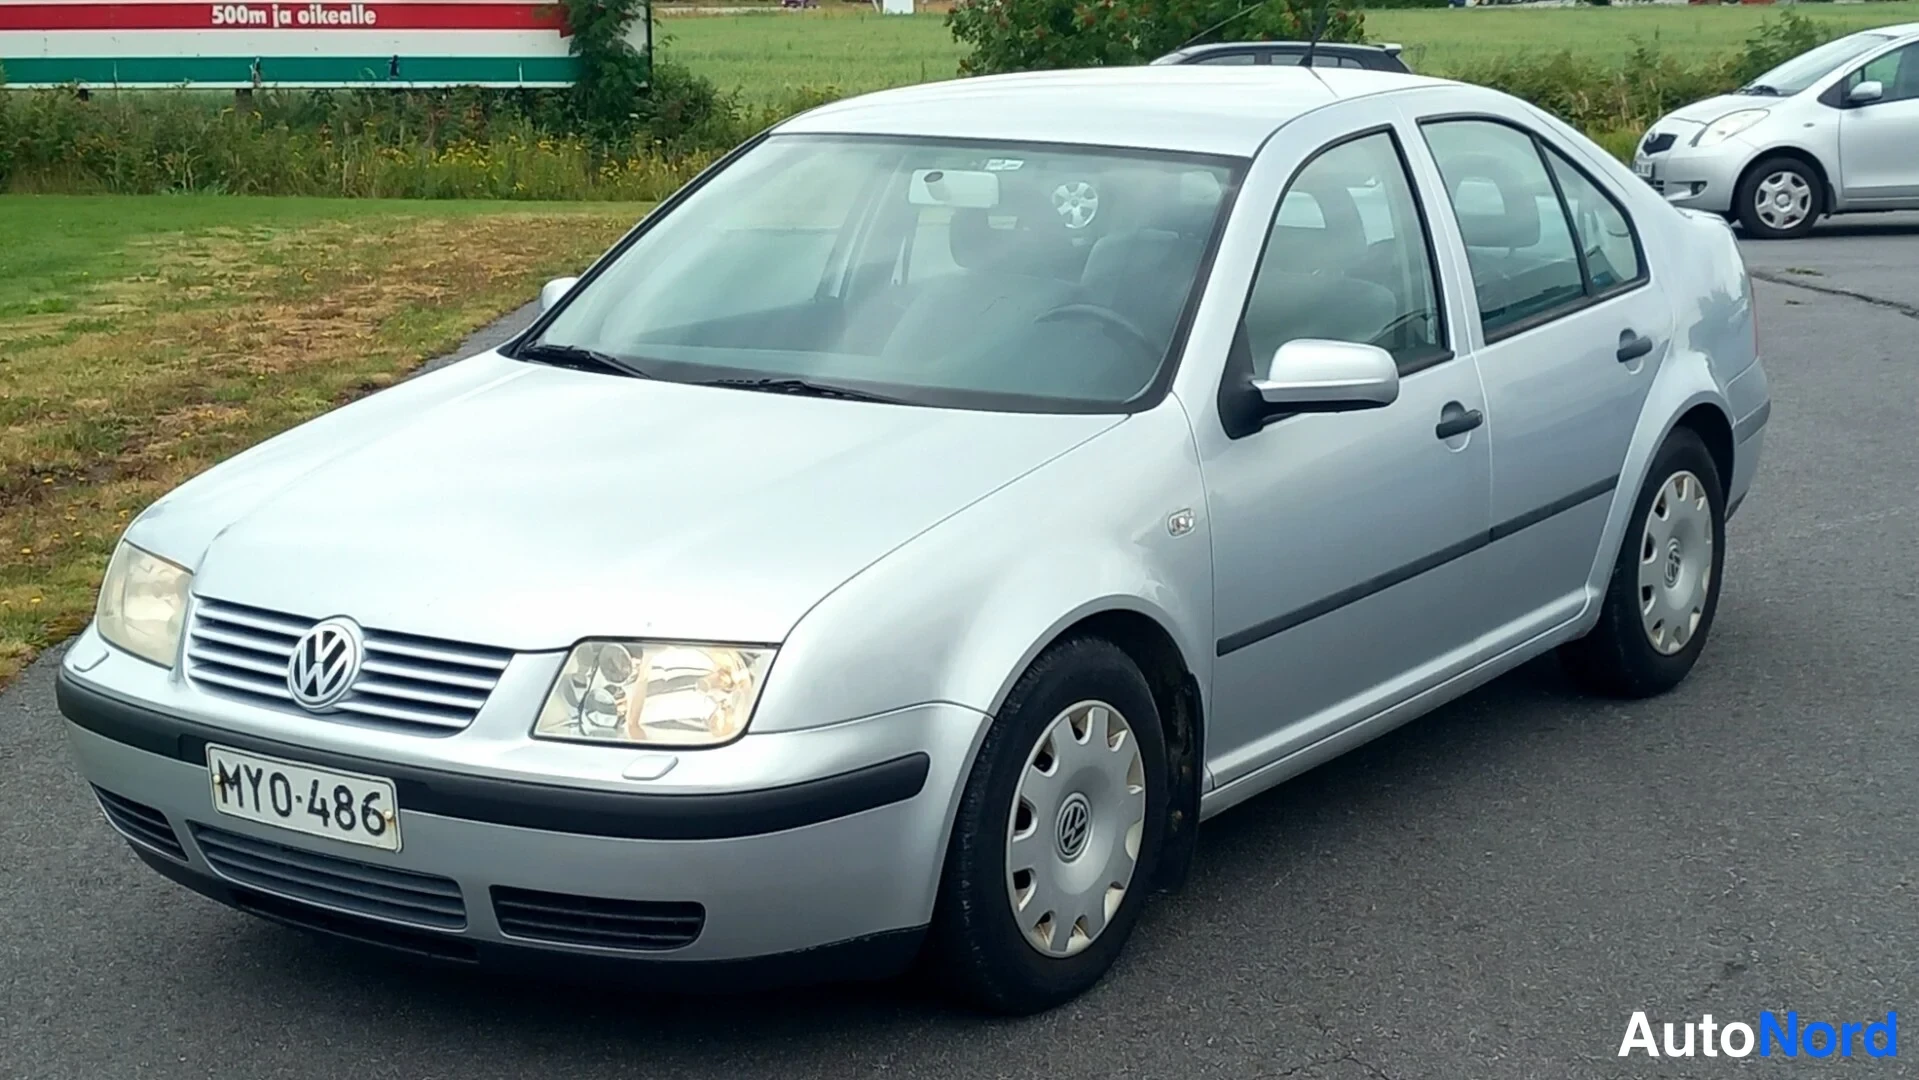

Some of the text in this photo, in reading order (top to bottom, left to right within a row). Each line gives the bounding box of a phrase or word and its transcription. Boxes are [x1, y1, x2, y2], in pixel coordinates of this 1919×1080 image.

[211, 4, 377, 28] 500m ja oikealle
[217, 758, 387, 837] MYO-486
